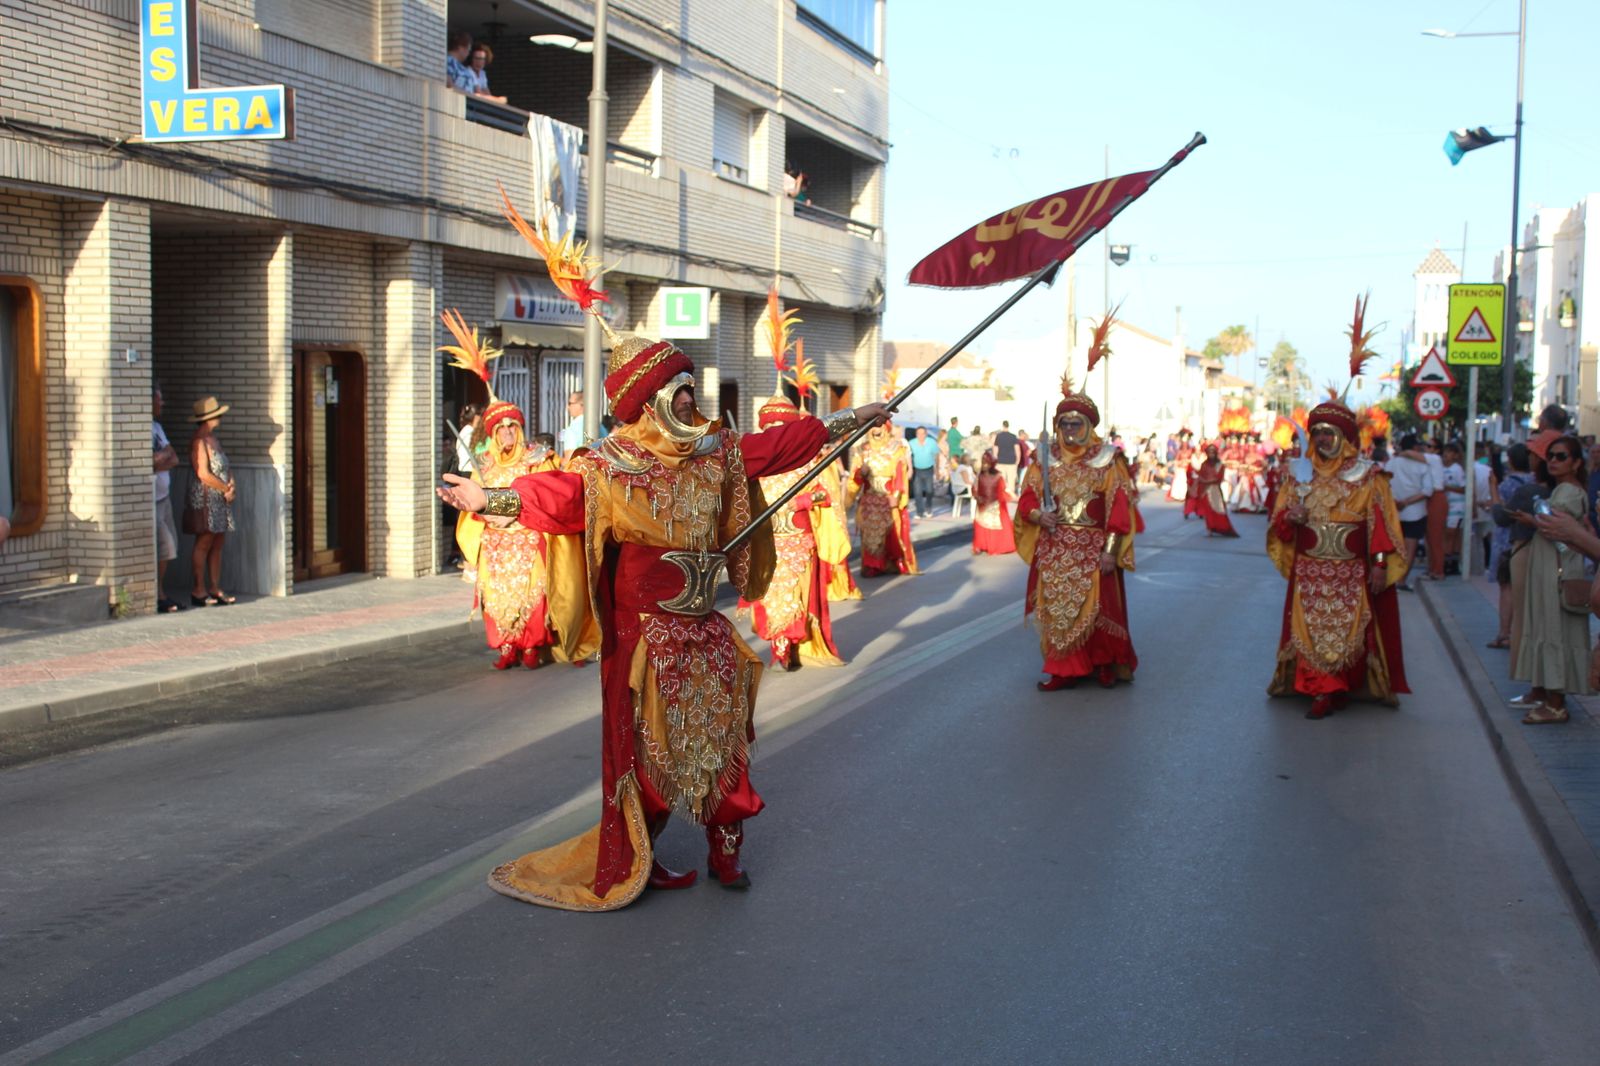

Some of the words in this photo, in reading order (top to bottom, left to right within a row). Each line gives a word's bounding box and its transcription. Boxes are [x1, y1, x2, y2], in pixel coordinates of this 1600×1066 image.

[150, 95, 273, 133] VERA
[1453, 287, 1502, 297] ATENCIÓN
[675, 296, 691, 321] L
[1451, 351, 1498, 360] COLEGIO
[1422, 398, 1441, 410] 30
